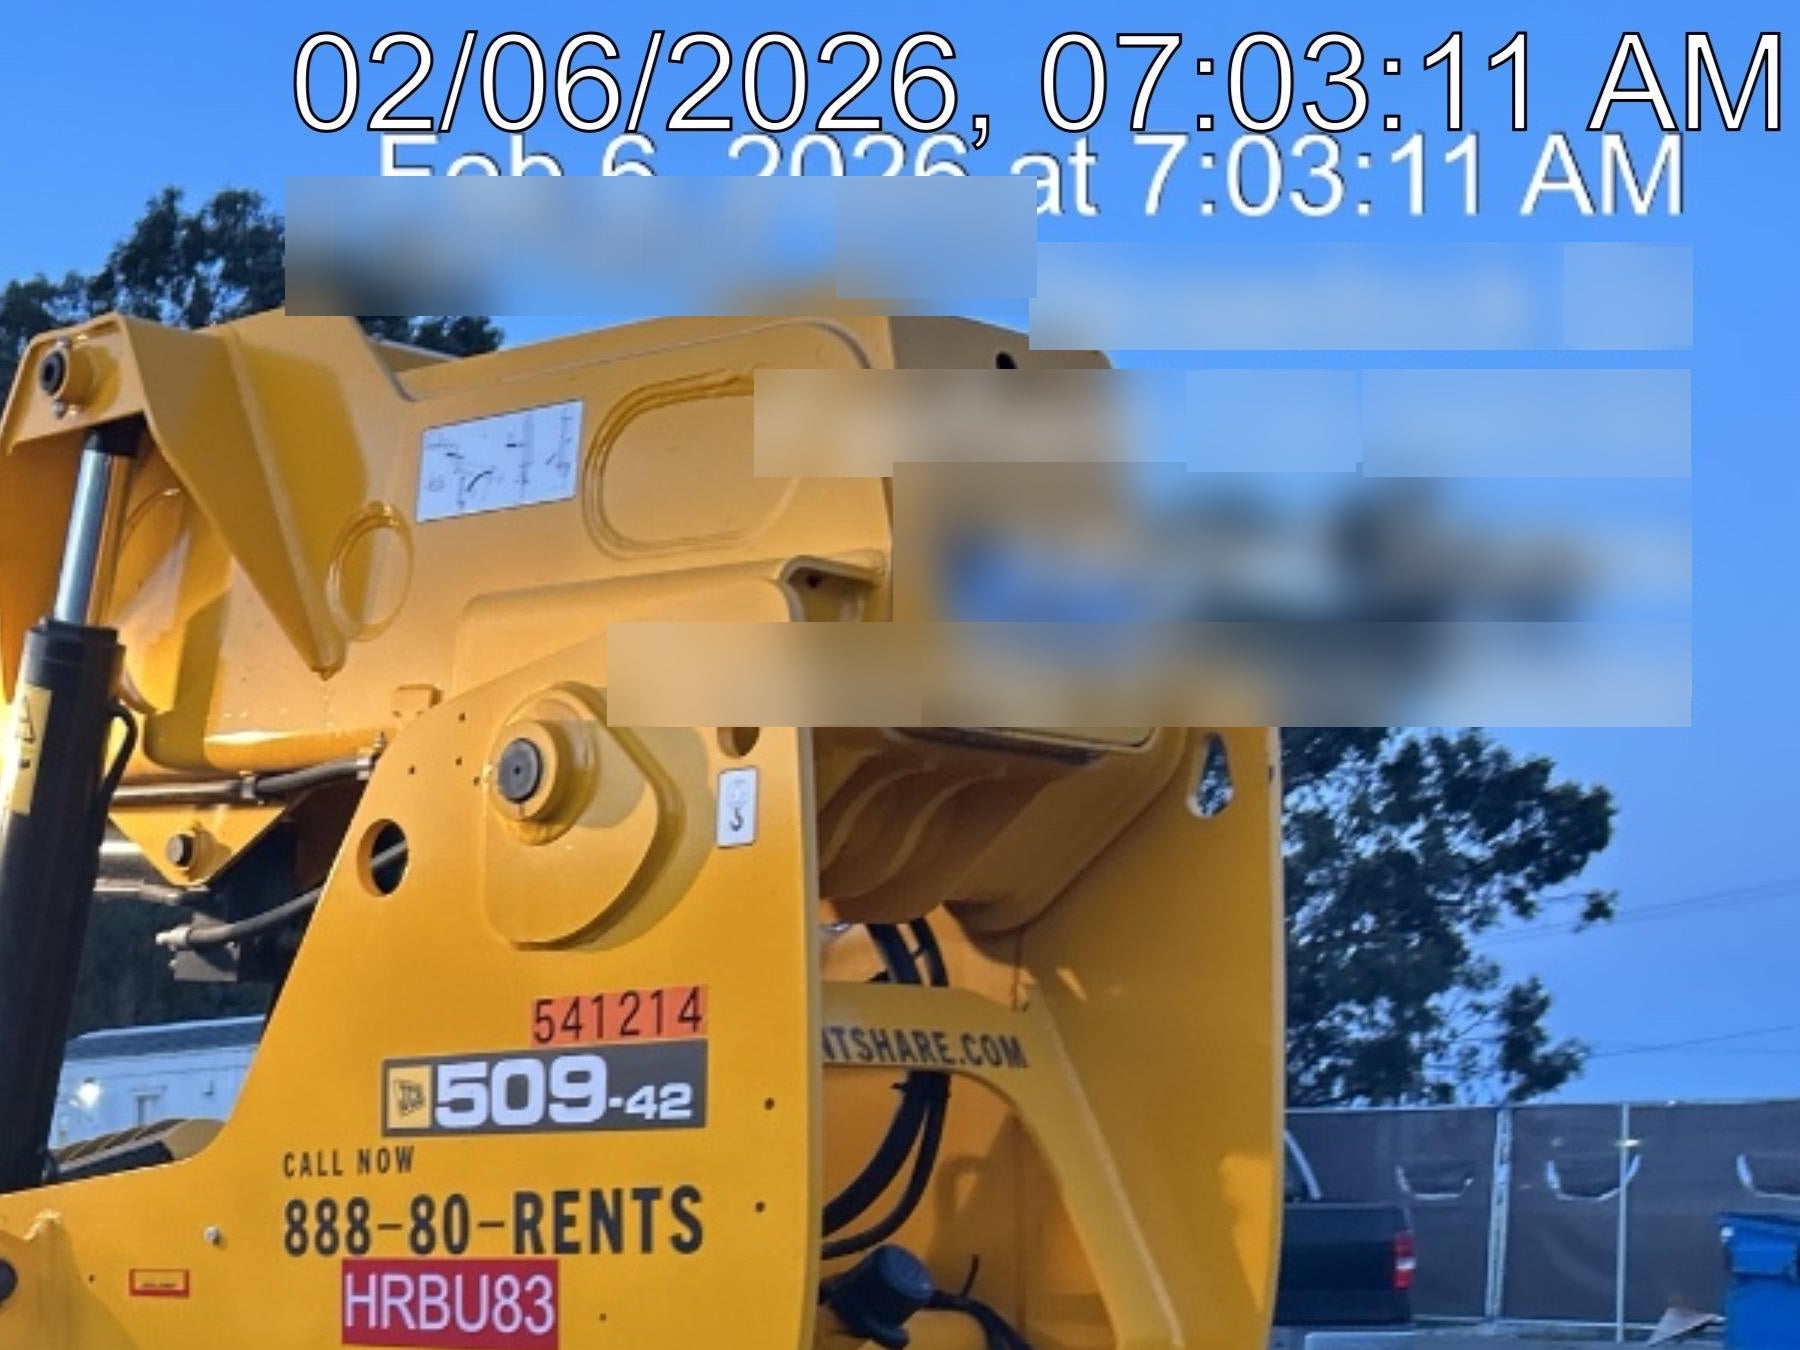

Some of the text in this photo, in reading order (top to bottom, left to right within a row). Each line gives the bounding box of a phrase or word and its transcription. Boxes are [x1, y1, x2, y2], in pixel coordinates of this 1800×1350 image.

[534, 985, 703, 1044] 541214
[434, 1054, 695, 1128] 509-42
[283, 1146, 415, 1177] CALL NOW
[283, 1184, 704, 1257] 888-80-RENTS
[343, 1272, 555, 1336] HRBU83
